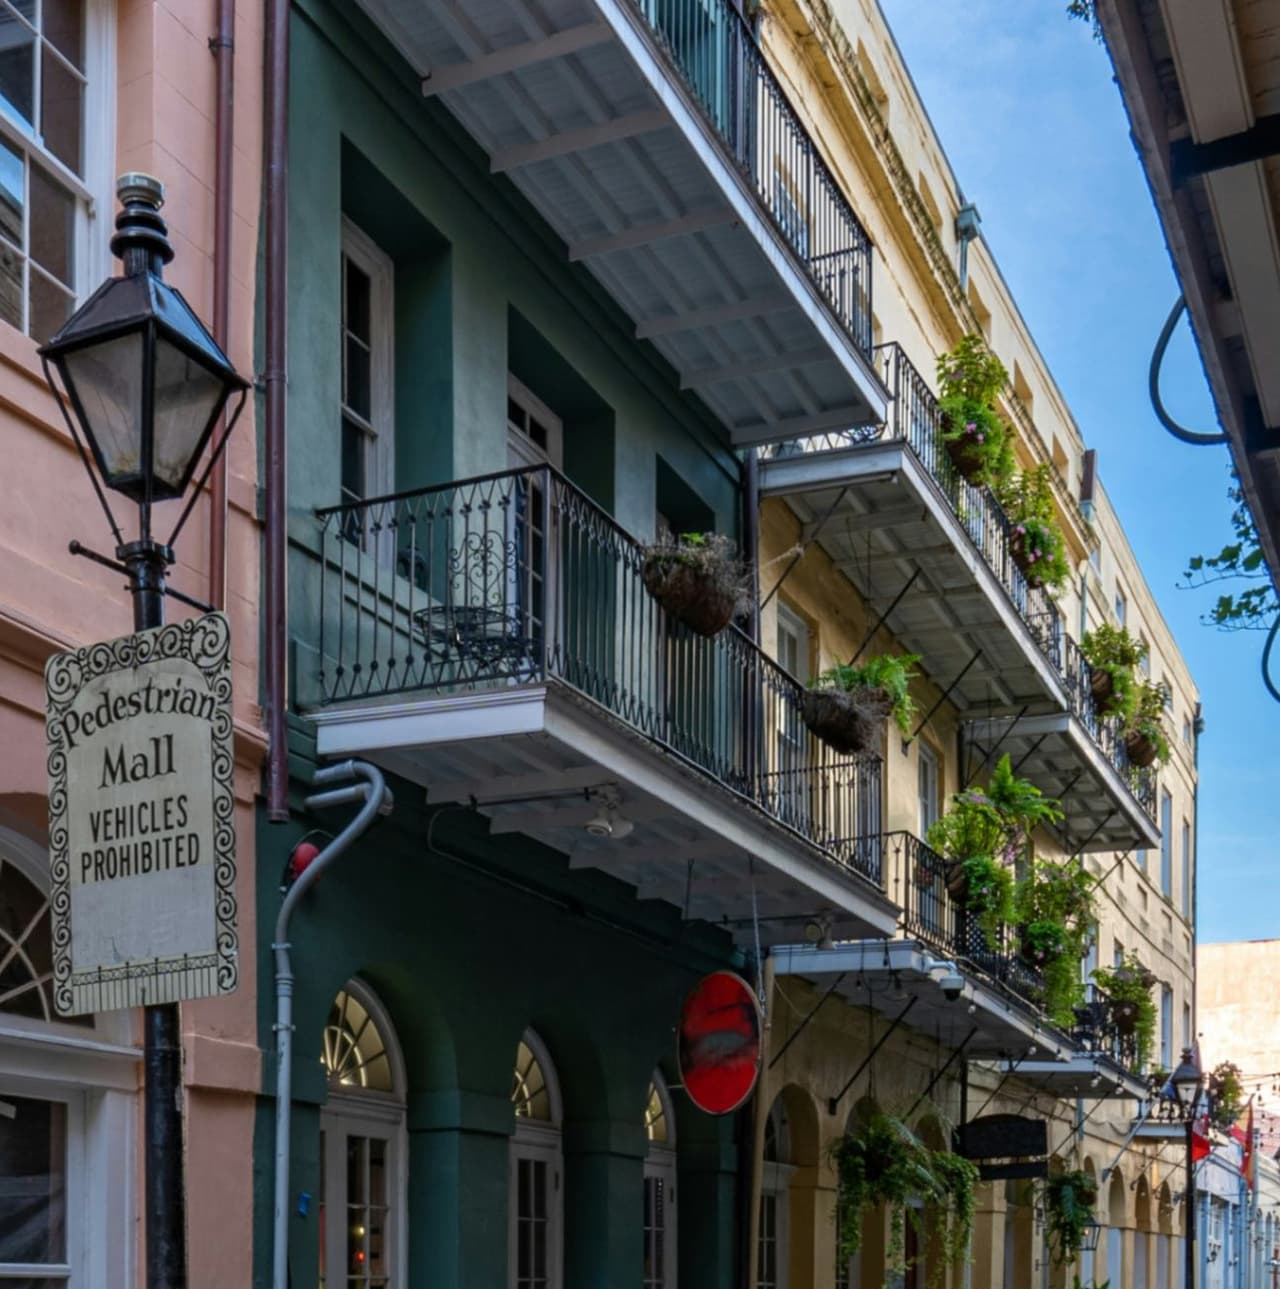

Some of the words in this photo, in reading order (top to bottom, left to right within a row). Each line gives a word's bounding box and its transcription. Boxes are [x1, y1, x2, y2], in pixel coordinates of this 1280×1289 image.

[61, 677, 216, 748] Pedestrian
[98, 734, 176, 789] Mall
[90, 795, 188, 843] VEHICLES
[81, 833, 199, 883] PROHIBITED
